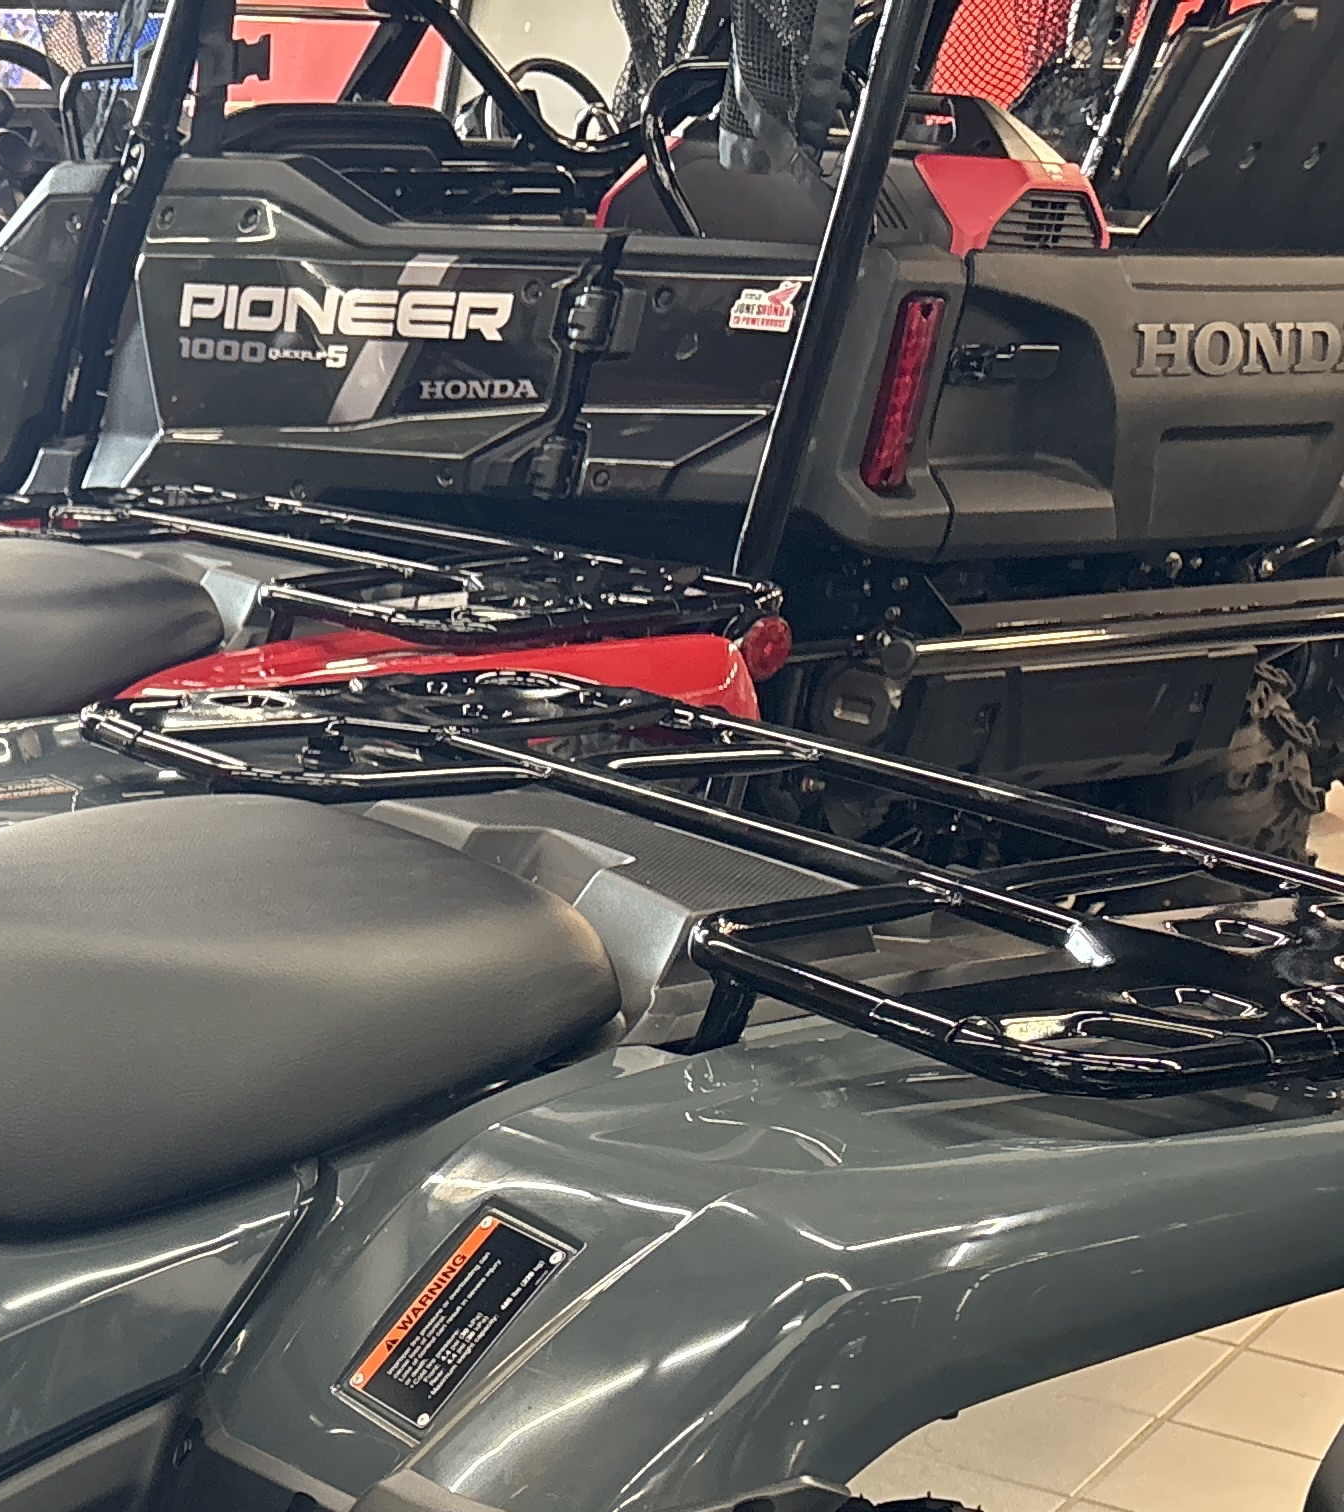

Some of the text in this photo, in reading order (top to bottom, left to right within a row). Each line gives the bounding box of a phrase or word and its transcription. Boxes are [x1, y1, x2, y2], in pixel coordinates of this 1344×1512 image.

[178, 282, 514, 341] PIONEER
[178, 336, 267, 364] 1000
[1130, 321, 1344, 377] HOND
[420, 378, 539, 401] HONDA
[397, 1254, 467, 1331] WARNING
